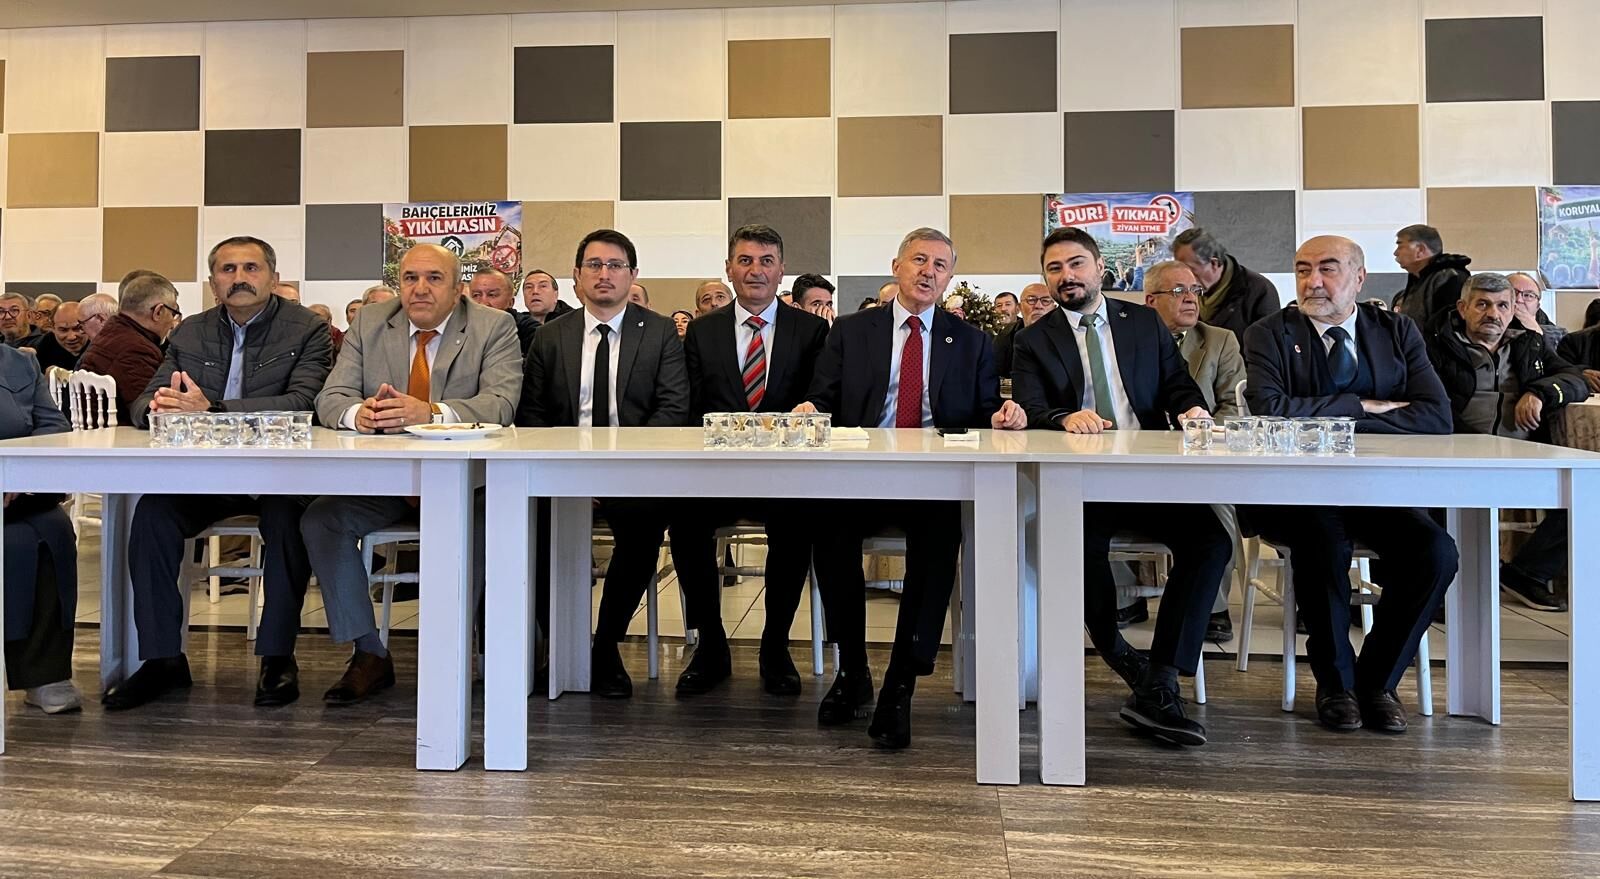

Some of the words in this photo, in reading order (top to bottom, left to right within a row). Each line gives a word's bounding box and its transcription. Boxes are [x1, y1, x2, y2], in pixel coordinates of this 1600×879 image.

[402, 202, 497, 219] BAHÇELERİMİZ
[1064, 205, 1104, 224] DUR!
[1115, 208, 1164, 221] YIKMA!
[406, 218, 496, 235] YIKILMASIN
[1116, 223, 1139, 232] ZİYAN
[1140, 224, 1161, 232] ETME
